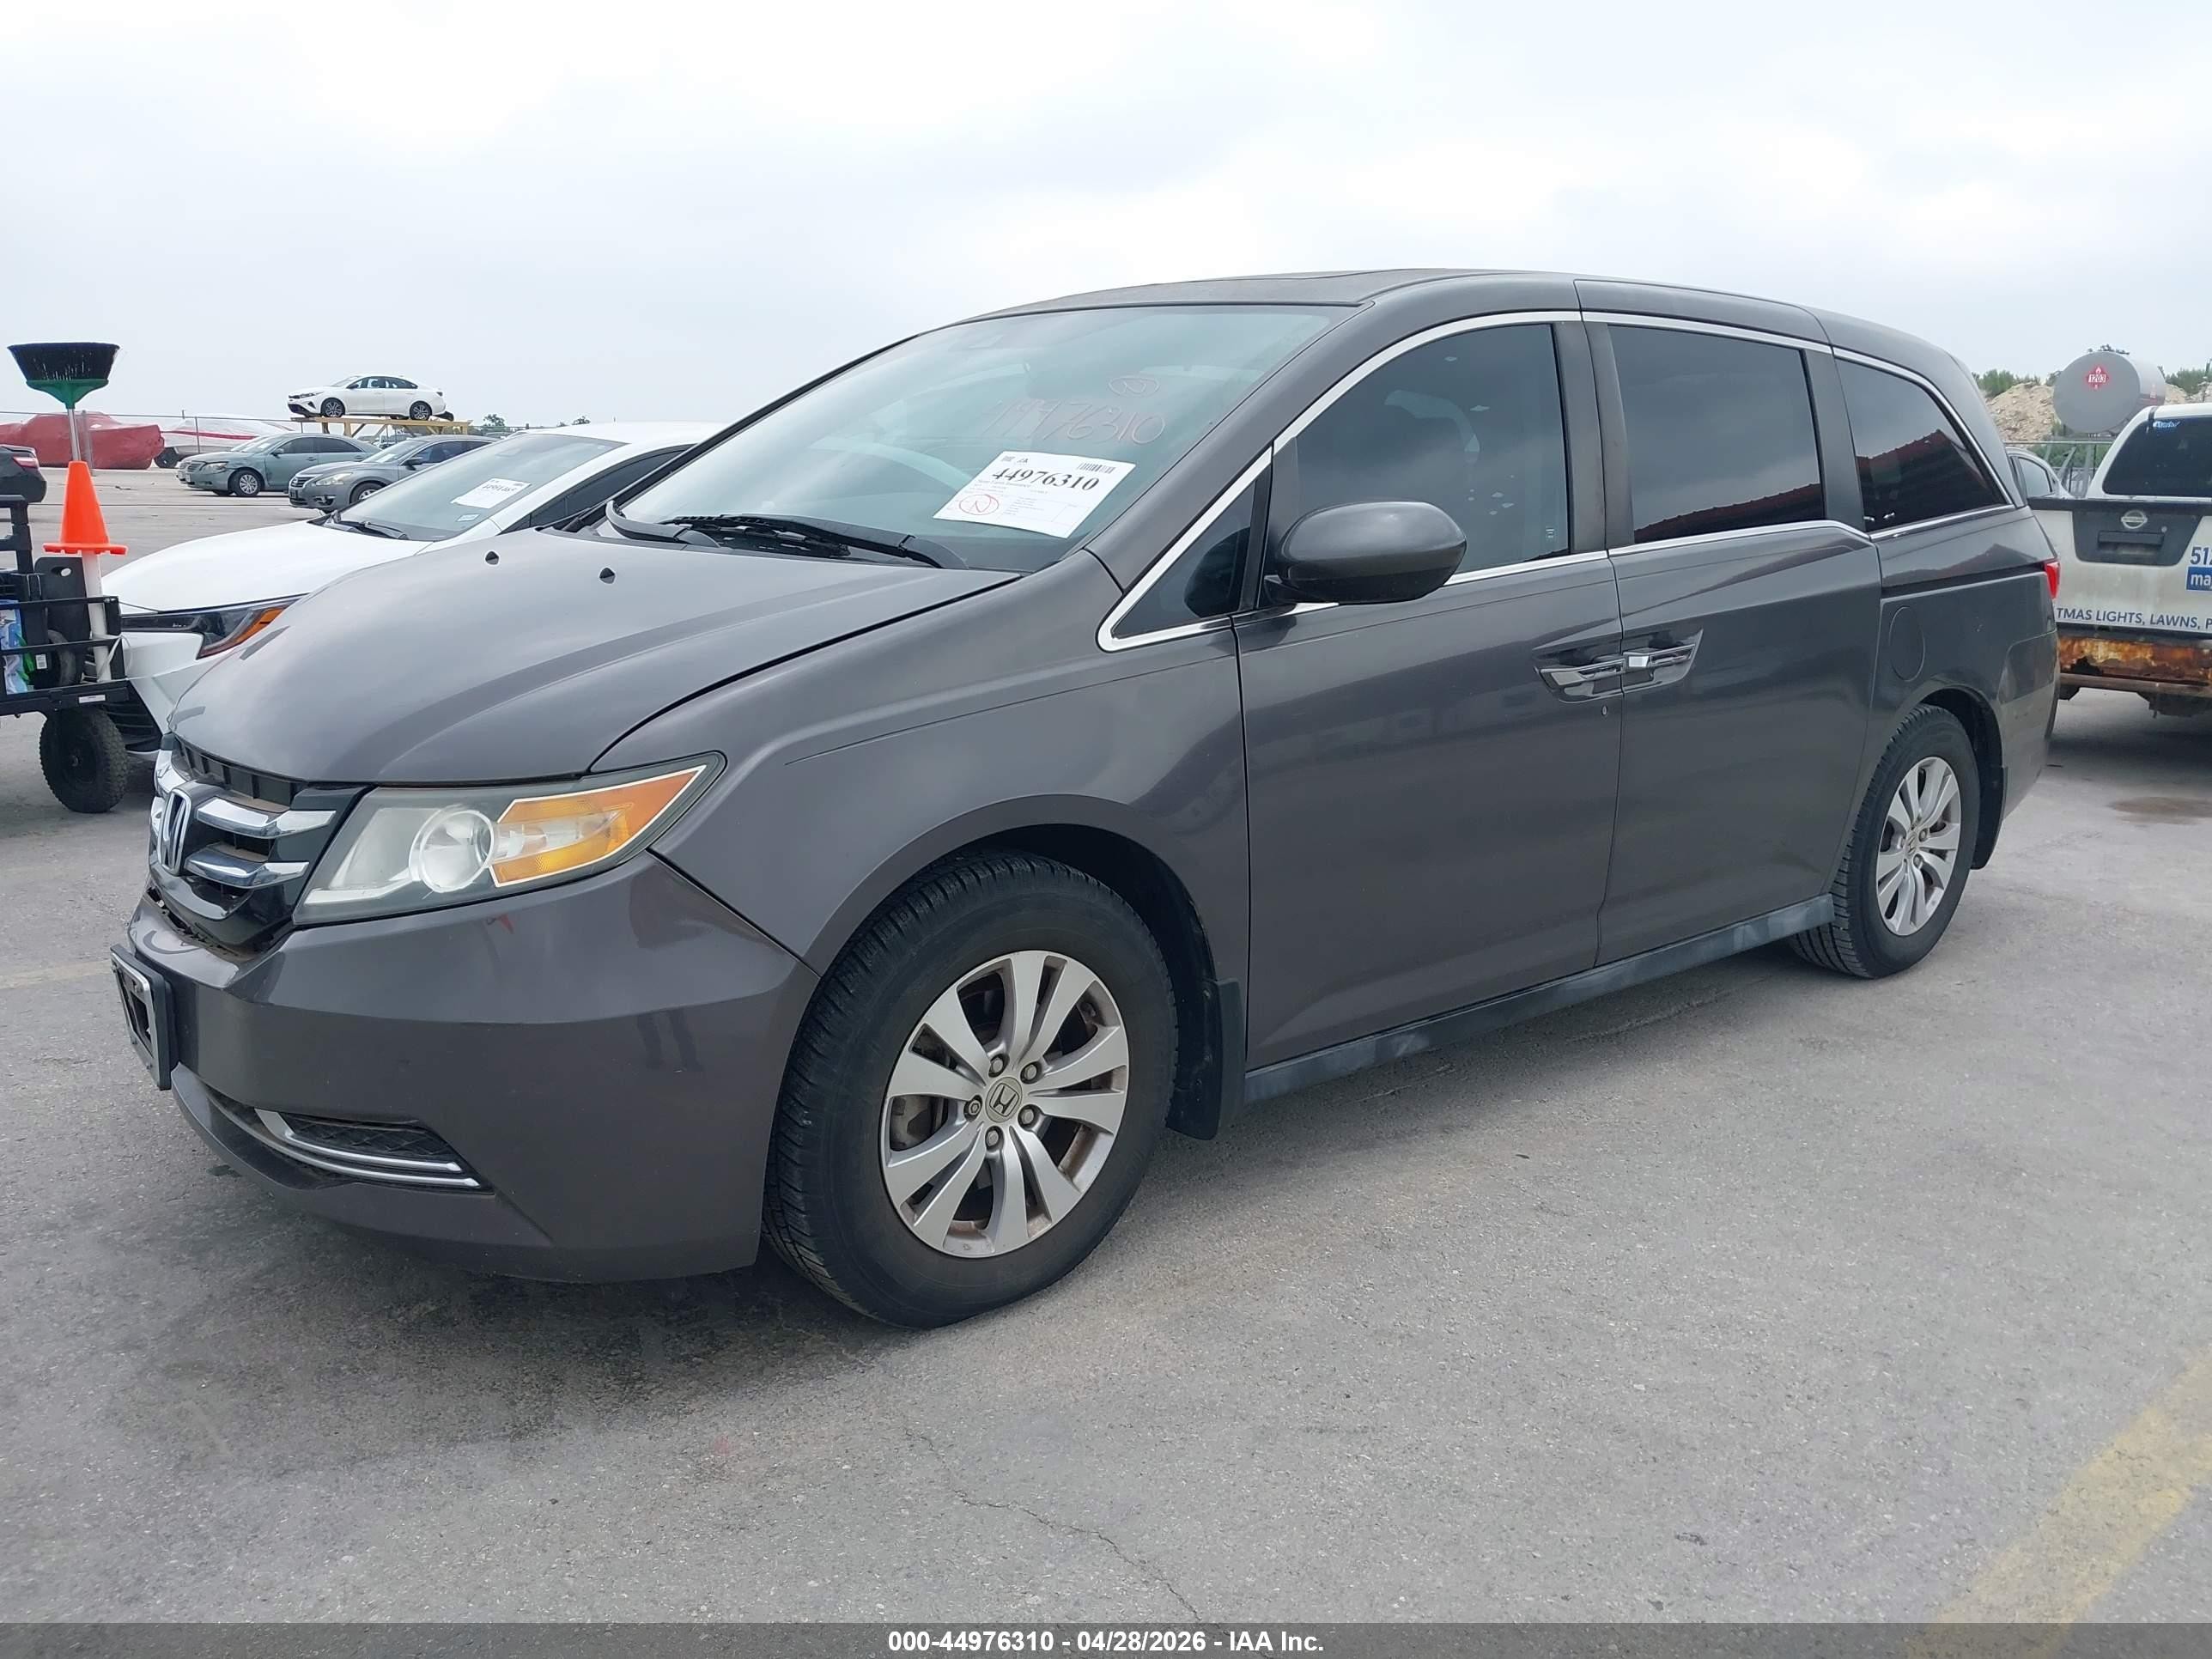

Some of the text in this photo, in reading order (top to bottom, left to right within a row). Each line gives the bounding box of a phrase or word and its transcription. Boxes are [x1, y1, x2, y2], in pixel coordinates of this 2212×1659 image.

[992, 467, 1100, 491] 44976310
[2191, 574, 2212, 590] ma
[2095, 610, 2146, 626] LIGHTS,
[2149, 613, 2201, 629] LAWNS,
